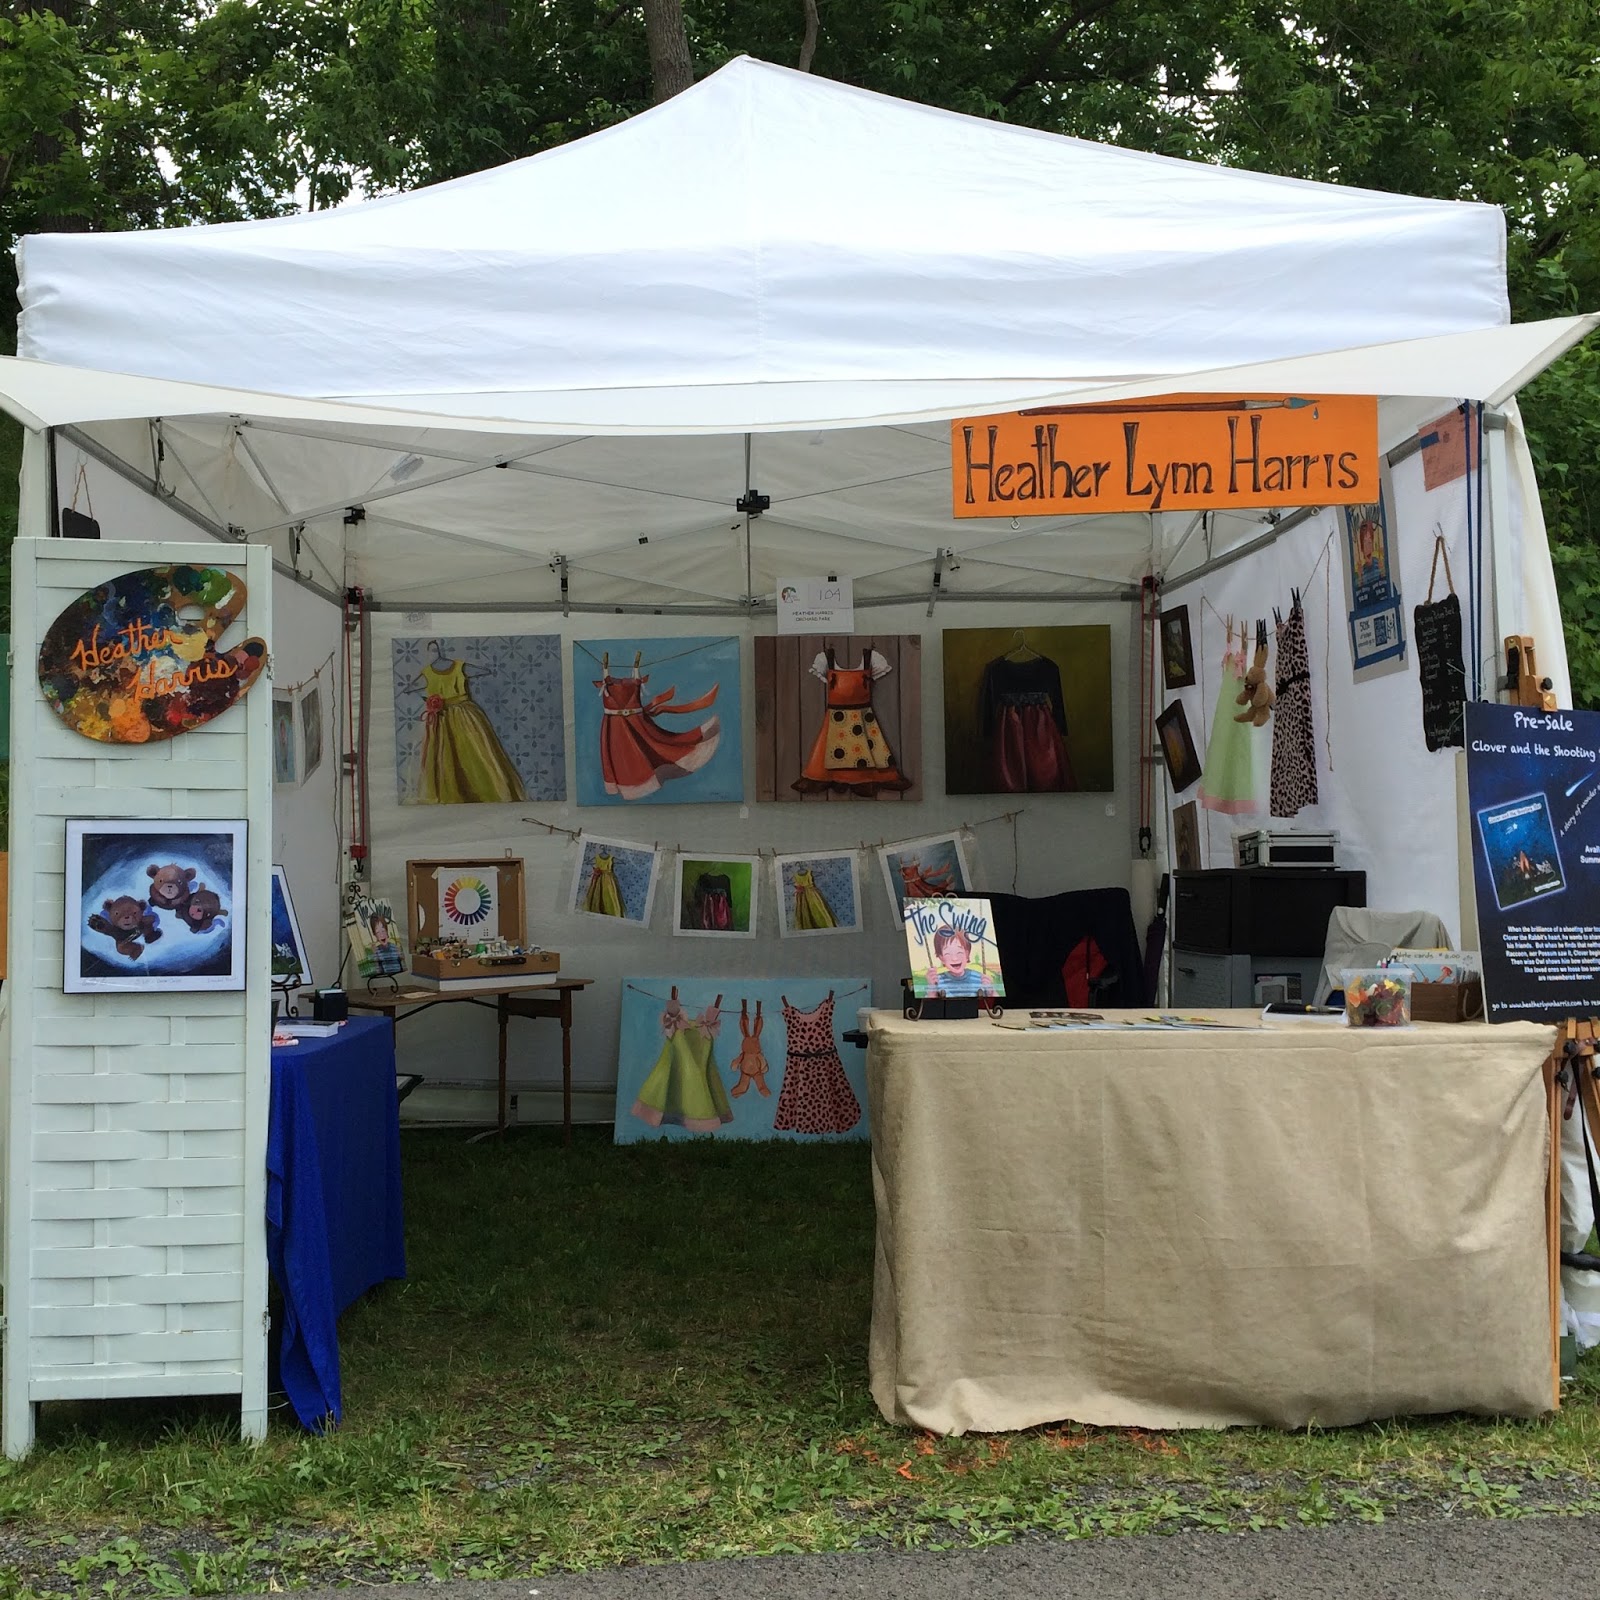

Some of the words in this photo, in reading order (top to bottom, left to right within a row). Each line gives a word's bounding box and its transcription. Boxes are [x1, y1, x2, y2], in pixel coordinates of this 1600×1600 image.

[963, 425, 1110, 503] Heather
[1123, 422, 1214, 509] Lynn
[1227, 415, 1360, 494] Harris
[69, 618, 183, 671] Heather
[126, 659, 238, 702] Harris
[1513, 711, 1574, 732] Pre-Sale
[1471, 740, 1507, 753] Clover
[1510, 742, 1531, 755] and
[1534, 744, 1551, 756] the
[1554, 745, 1596, 763] Shooting
[938, 901, 998, 947] Swing
[1396, 951, 1411, 959] Note
[1492, 1003, 1500, 1011] go
[1501, 1001, 1508, 1009] to
